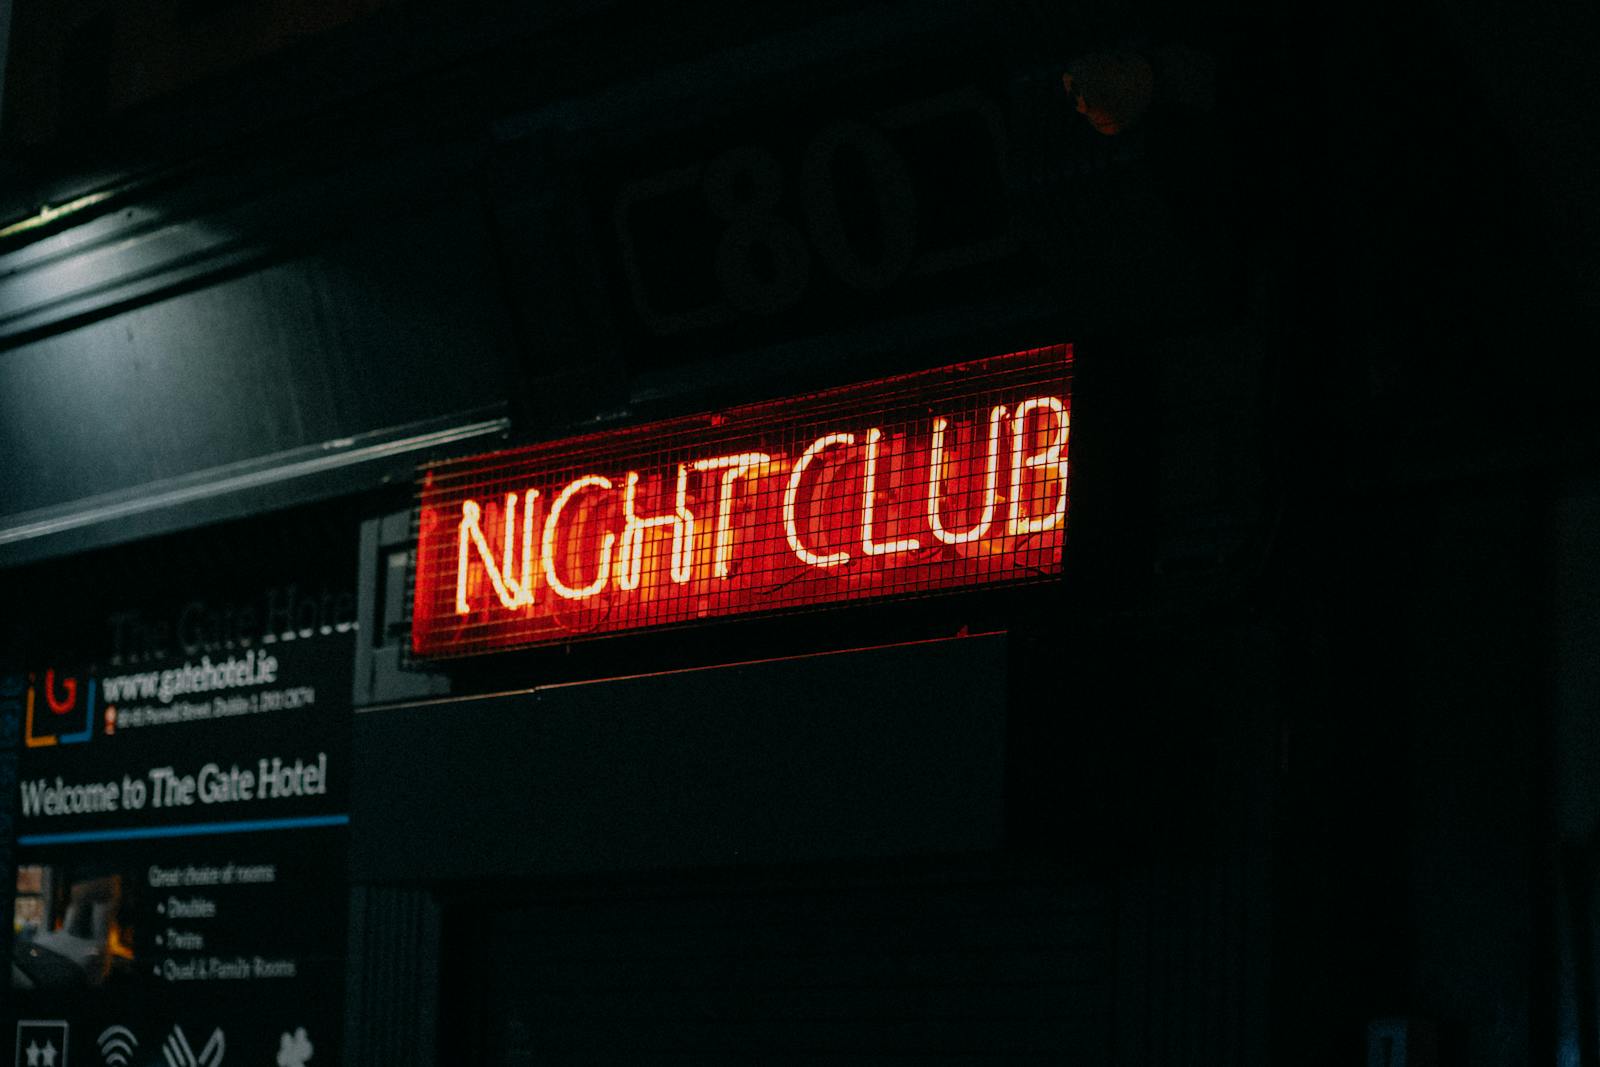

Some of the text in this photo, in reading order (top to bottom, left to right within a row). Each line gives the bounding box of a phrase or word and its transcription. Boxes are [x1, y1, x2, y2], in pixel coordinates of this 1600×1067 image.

[702, 117, 918, 317] 80
[456, 395, 1072, 615] NIGHT CLUB
[102, 648, 279, 704] www.gatehotel.ie
[19, 751, 328, 818] Welcome to The Gate Hotel
[209, 955, 250, 981] Family
